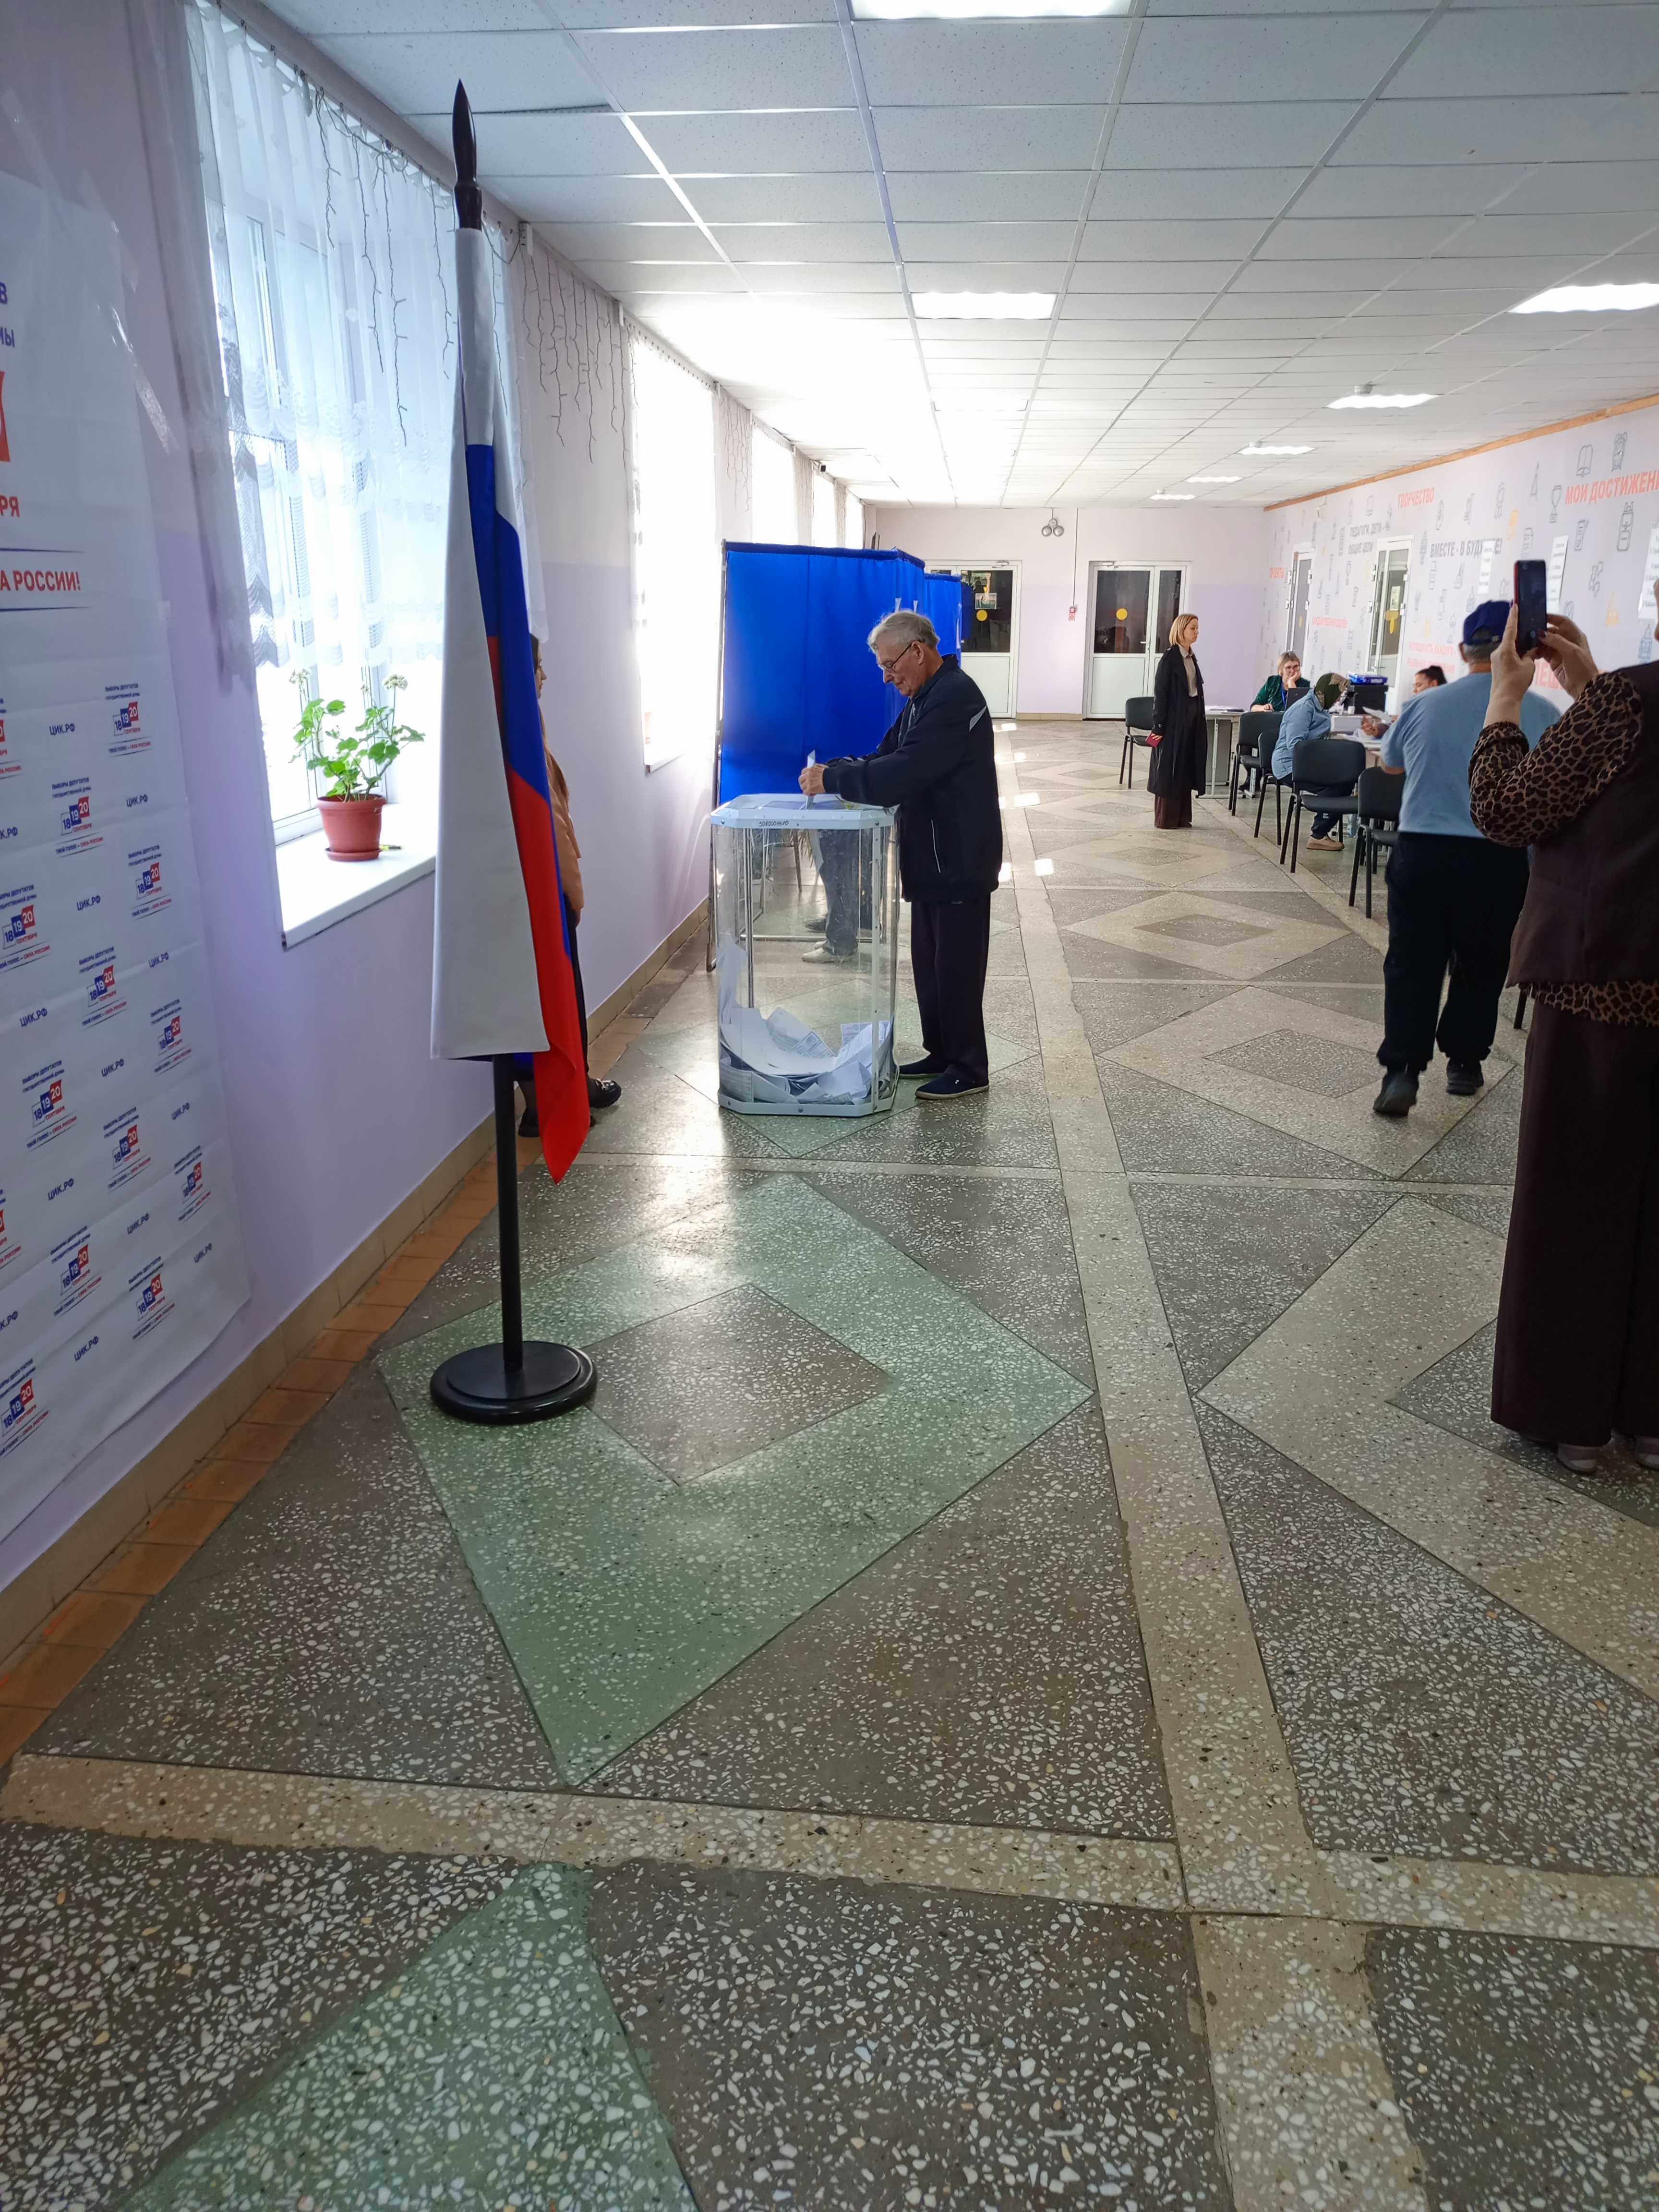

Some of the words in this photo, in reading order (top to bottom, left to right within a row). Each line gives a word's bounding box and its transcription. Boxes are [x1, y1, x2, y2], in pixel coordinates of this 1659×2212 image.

[1397, 487, 1435, 509] ТВОРЧЕСТВО
[1565, 483, 1588, 505] МОИ
[1430, 541, 1455, 558] ВМЕСТЕ
[1460, 541, 1465, 556] В
[13, 570, 81, 591] РОССИИ!
[1270, 567, 1284, 579] ПРОЕКТЫ
[49, 722, 75, 736] ЦИК.РФ
[115, 720, 122, 731] 18
[122, 713, 129, 723] 19
[129, 707, 137, 717] 20
[127, 794, 148, 807] ЦИК.РФ
[63, 818, 71, 830] 18
[71, 810, 79, 821] 19
[79, 802, 88, 814] 20
[137, 883, 144, 894] 18
[144, 875, 151, 885] 19
[151, 867, 159, 879] 20
[77, 895, 101, 911] ЦИК.РФ
[5, 930, 13, 943] 18
[13, 920, 22, 933] 19
[22, 911, 33, 924] 20
[148, 952, 169, 968] ЦИК.РФ
[90, 989, 97, 1001] 18
[96, 981, 105, 991] 19
[104, 971, 112, 983] 20
[20, 1008, 48, 1027] ЦИК.РФ
[101, 1058, 125, 1078] ЦИК.РФ
[34, 1108, 42, 1121] 18
[42, 1097, 50, 1109] 19
[50, 1086, 60, 1100] 20
[114, 1152, 120, 1163] 18
[121, 1142, 128, 1153] 19
[128, 1130, 136, 1143] 20
[48, 1178, 74, 1201] ЦИК.РФ
[127, 1213, 150, 1235] ЦИК.РФ
[193, 1242, 213, 1263] ЦИК.РФ
[62, 1276, 70, 1288] 18
[71, 1263, 78, 1276] 19
[79, 1251, 87, 1265] 20
[138, 1302, 146, 1314] 18
[145, 1291, 153, 1302] 19
[152, 1280, 160, 1292] 20
[74, 1336, 99, 1361] ЦИК.РФ
[3, 1414, 12, 1429] 18
[12, 1401, 21, 1414] 19
[21, 1385, 31, 1402] 20
